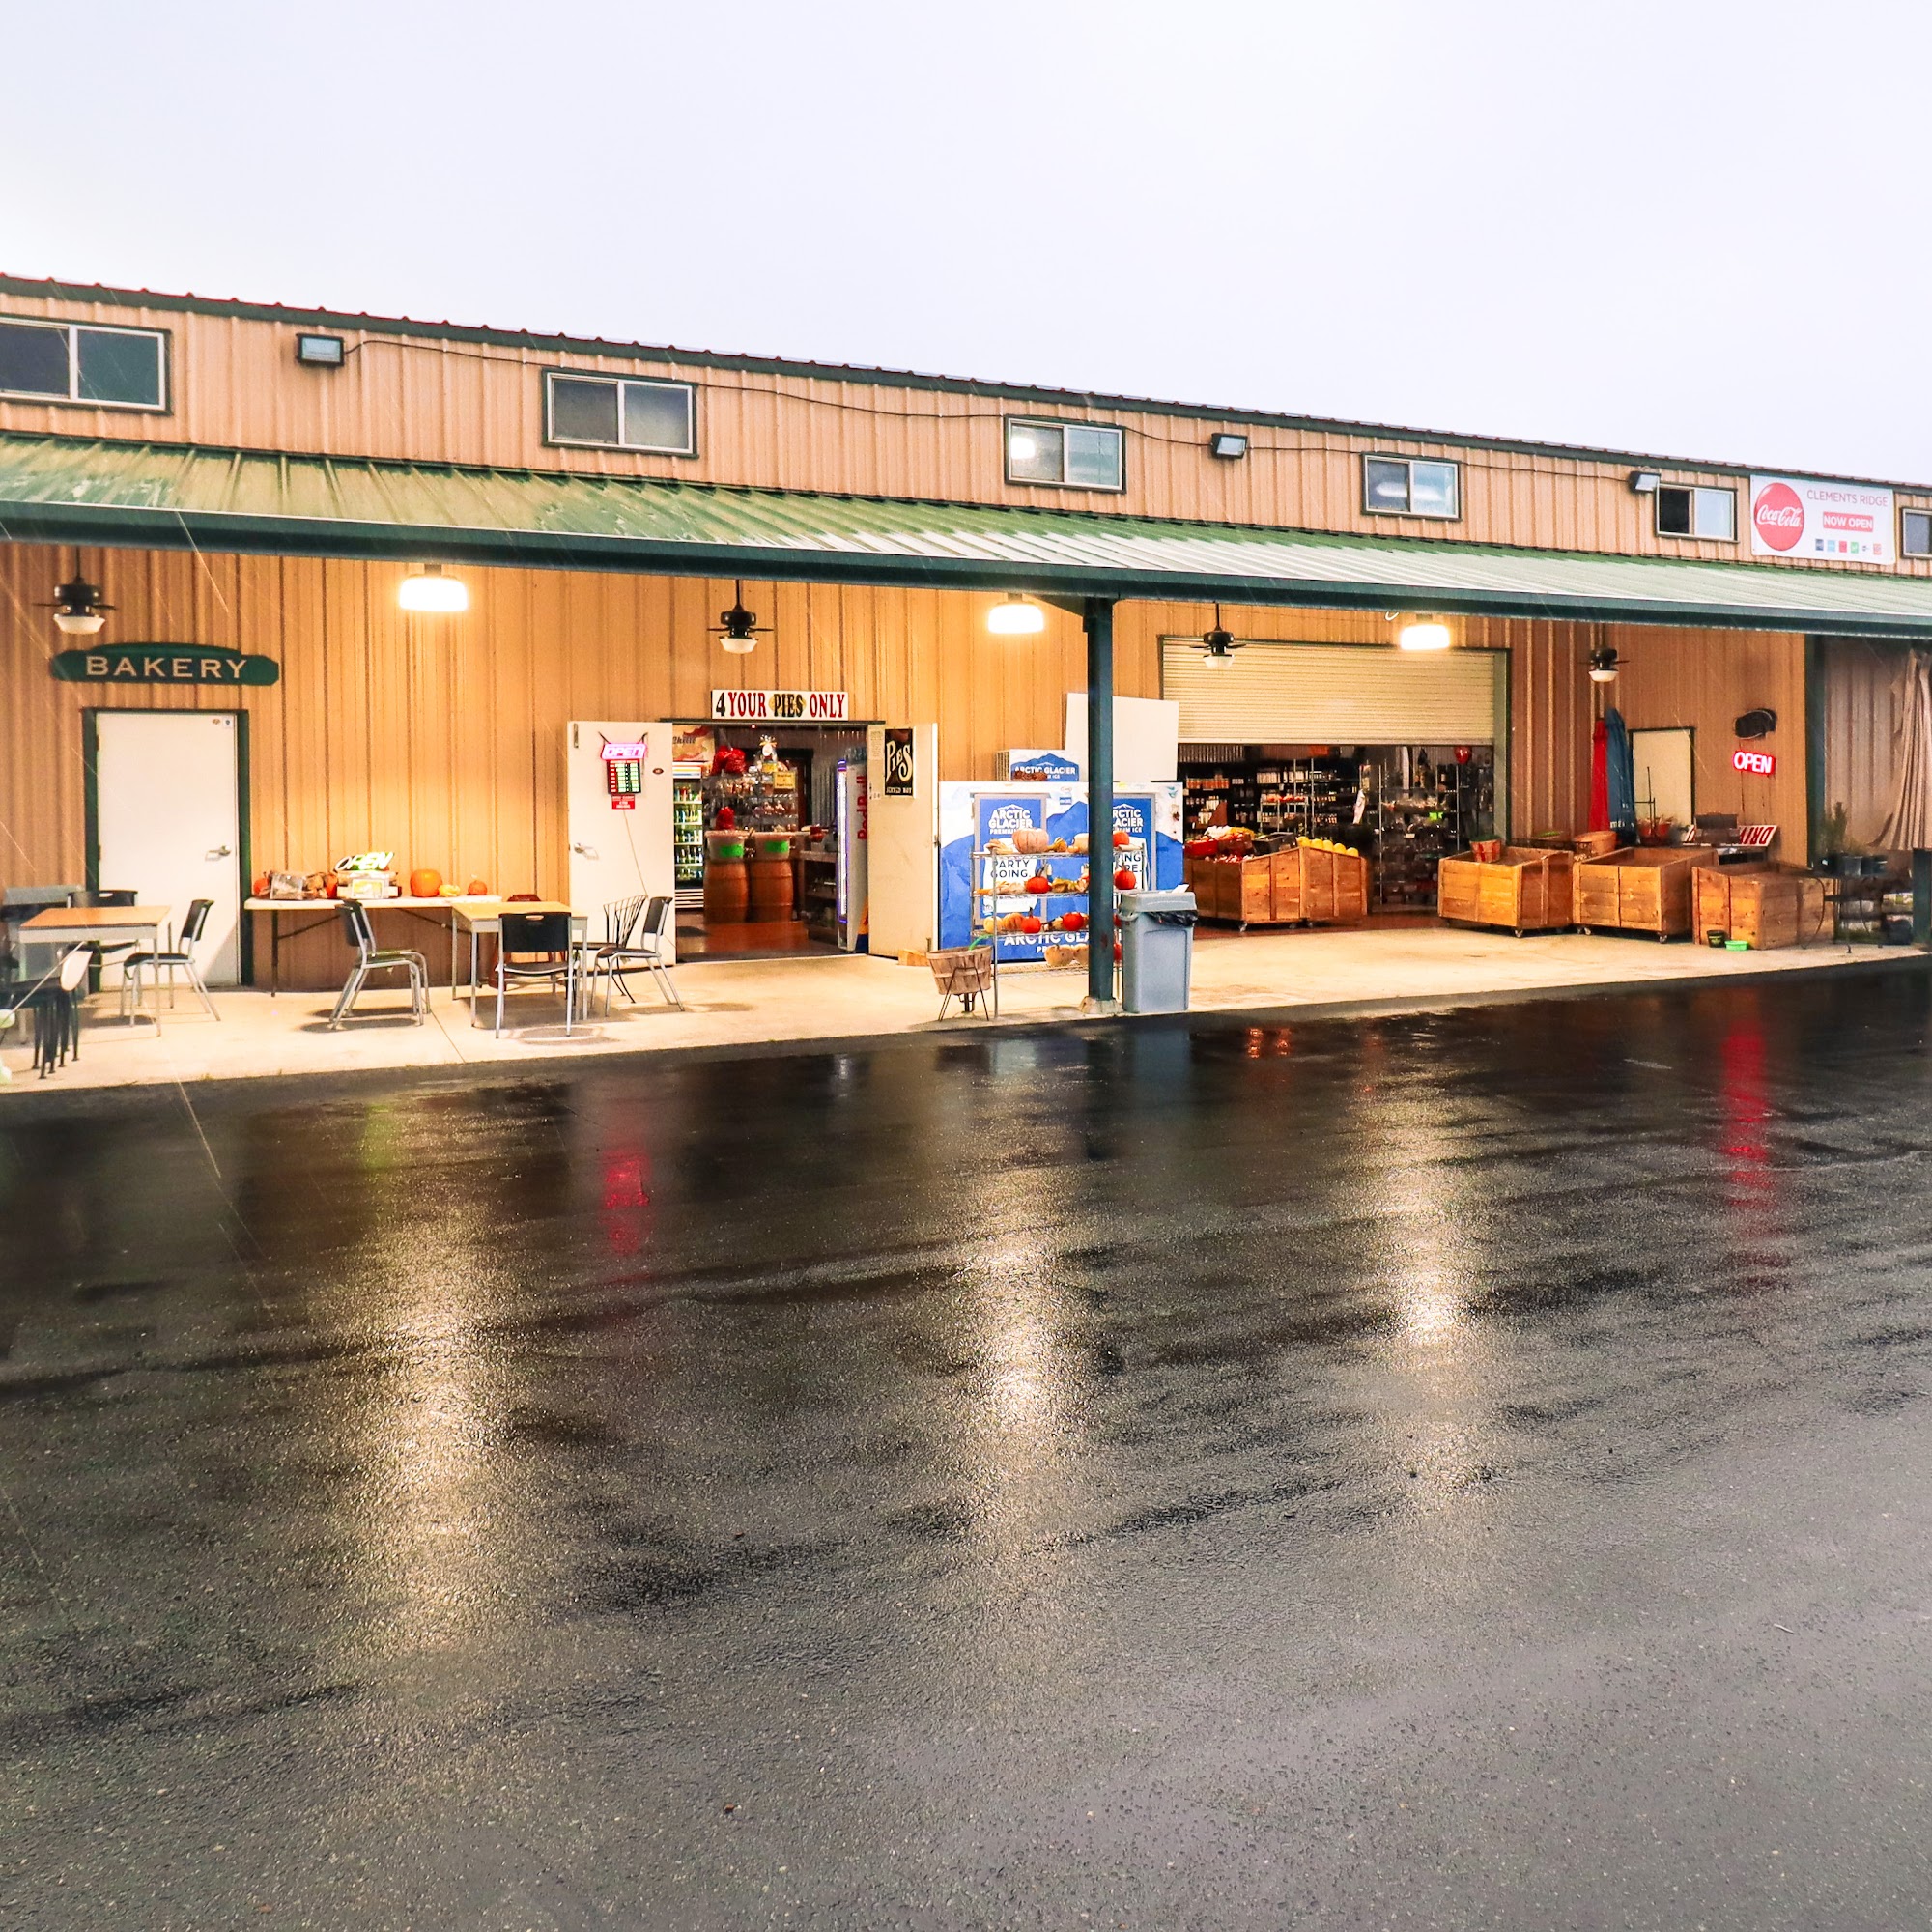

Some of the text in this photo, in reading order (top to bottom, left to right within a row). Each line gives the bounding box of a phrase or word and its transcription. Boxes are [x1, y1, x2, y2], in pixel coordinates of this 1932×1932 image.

[1807, 490, 1888, 507] CLEMENTS RIDGE
[1824, 515, 1873, 529] NOW OPEN
[86, 656, 246, 678] BAKERY
[715, 692, 845, 718] 4 YOUR PIES ONLY
[605, 745, 644, 757] OPEN
[1734, 752, 1772, 774] OPEN
[991, 810, 1031, 819] ARCTIC
[1113, 810, 1141, 818] RCTIC
[988, 818, 1033, 829] GLACIER
[335, 851, 394, 870] OPEN
